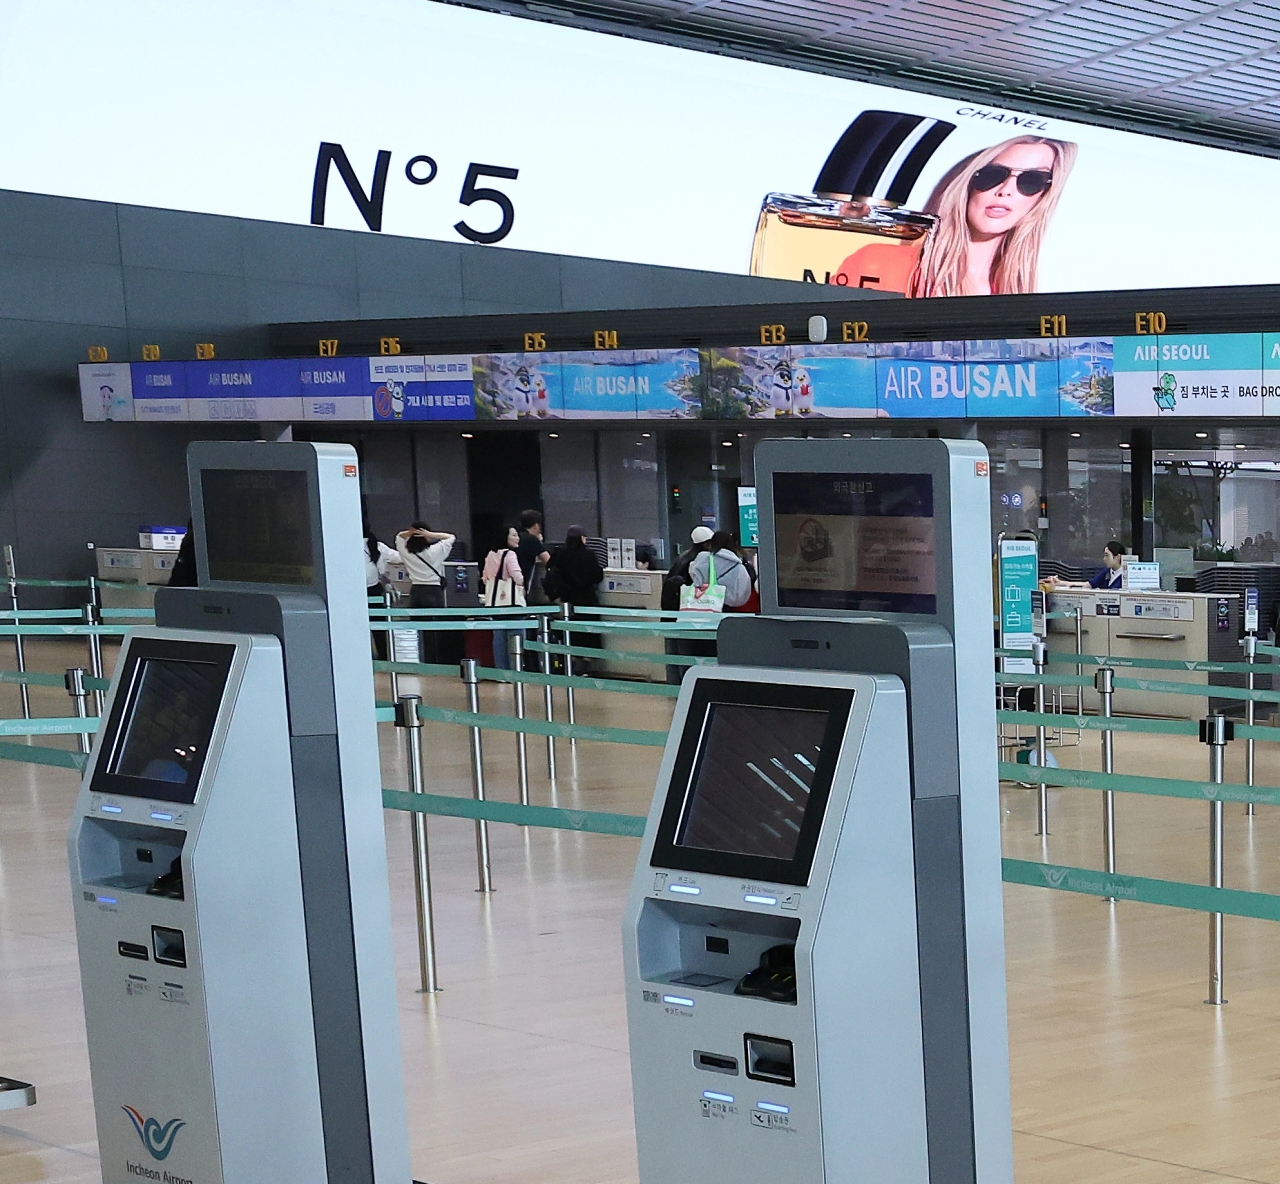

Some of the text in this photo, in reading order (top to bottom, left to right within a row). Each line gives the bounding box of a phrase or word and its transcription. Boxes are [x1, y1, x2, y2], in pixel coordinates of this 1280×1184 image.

[955, 107, 1049, 131] CHANEL
[842, 322, 869, 342] E12
[1040, 315, 1067, 337] E11
[1134, 312, 1167, 334] E10
[524, 332, 546, 351] E15
[594, 330, 618, 349] E14
[760, 325, 786, 345] E13
[319, 340, 338, 356] E17
[1134, 344, 1210, 361] AIR SEOUL
[573, 376, 649, 395] AIR BUSAN
[884, 364, 1037, 399] AIR BUSAN
[1180, 386, 1230, 399] 짐 부치는 곳
[1238, 386, 1258, 397] BAG
[126, 1160, 161, 1182] Incheon
